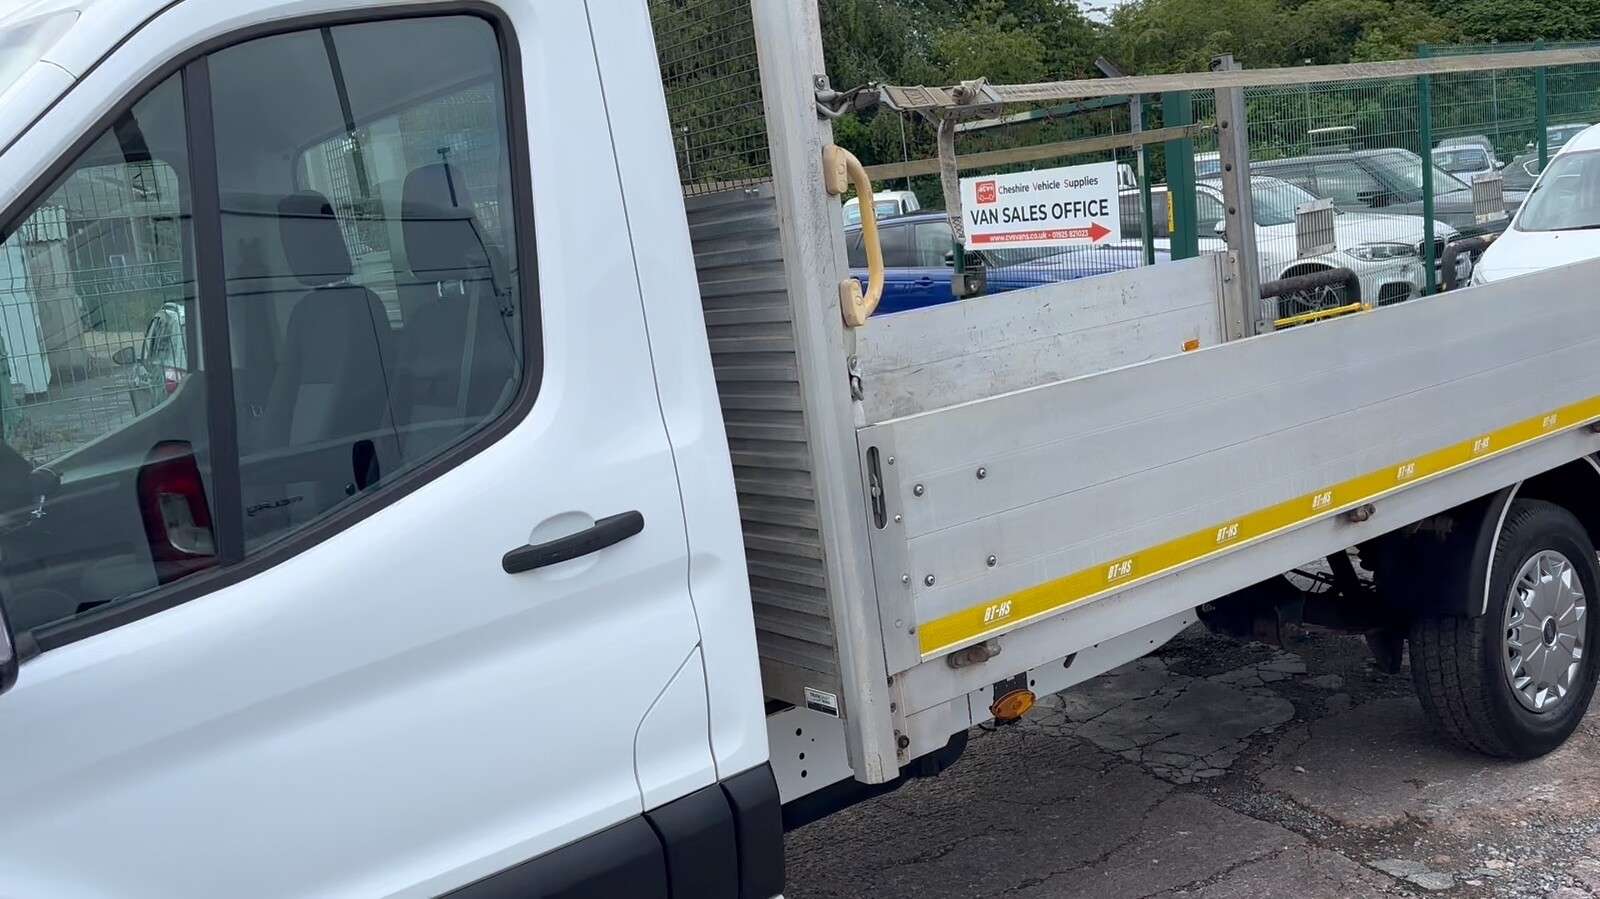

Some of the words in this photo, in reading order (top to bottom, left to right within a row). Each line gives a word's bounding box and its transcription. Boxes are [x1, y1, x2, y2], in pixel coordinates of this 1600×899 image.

[998, 183, 1030, 195] Cheshire
[1032, 180, 1060, 192] Vehicle
[1064, 176, 1099, 189] Supplies
[970, 208, 999, 225] VAN
[1002, 204, 1047, 224] SALES
[1051, 199, 1109, 220] OFFICE
[1312, 491, 1332, 508] BT-HS
[1216, 523, 1239, 542] BT-HS
[1107, 559, 1133, 580] BT-HS
[984, 600, 1012, 622] BT-HS
